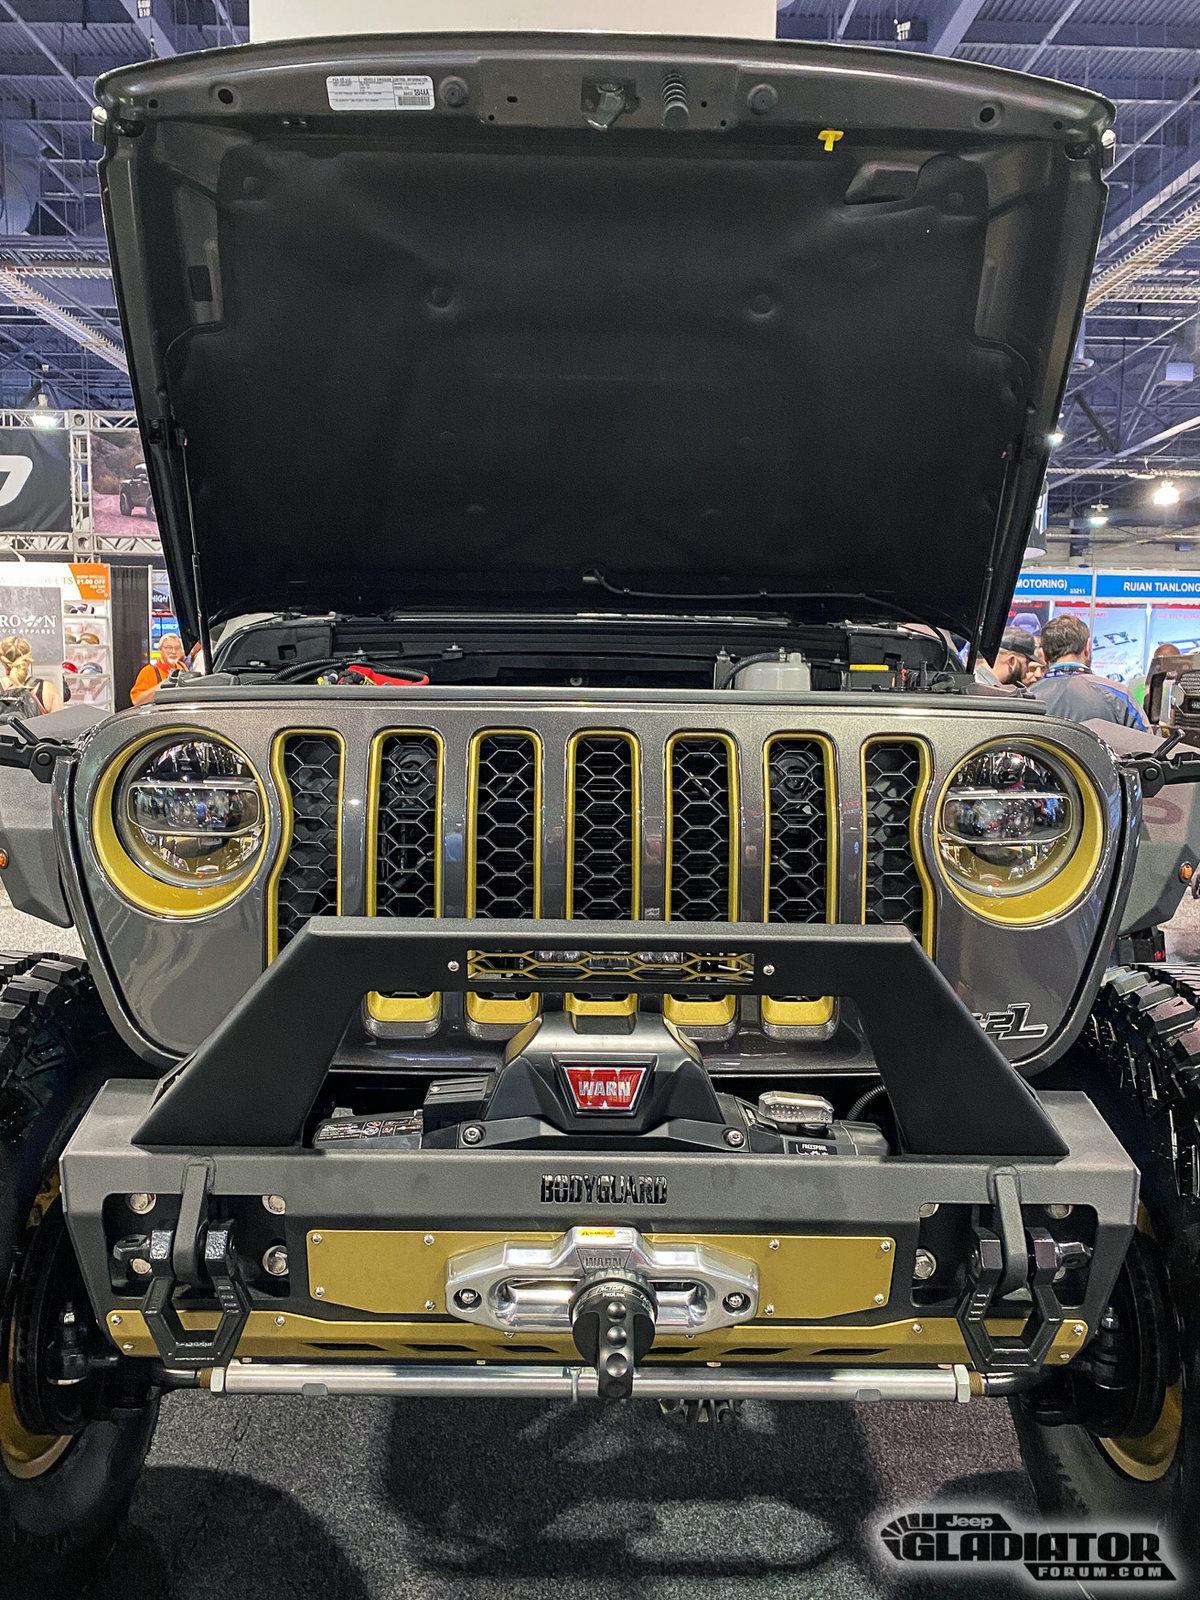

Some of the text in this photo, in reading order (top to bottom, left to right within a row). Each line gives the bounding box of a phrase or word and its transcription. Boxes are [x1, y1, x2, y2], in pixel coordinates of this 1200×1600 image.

[1123, 581, 1200, 594] RUIAN TIANLONG
[578, 1080, 631, 1097] WARN
[540, 1174, 668, 1205] BODYGUARD
[585, 1257, 622, 1269] WARN
